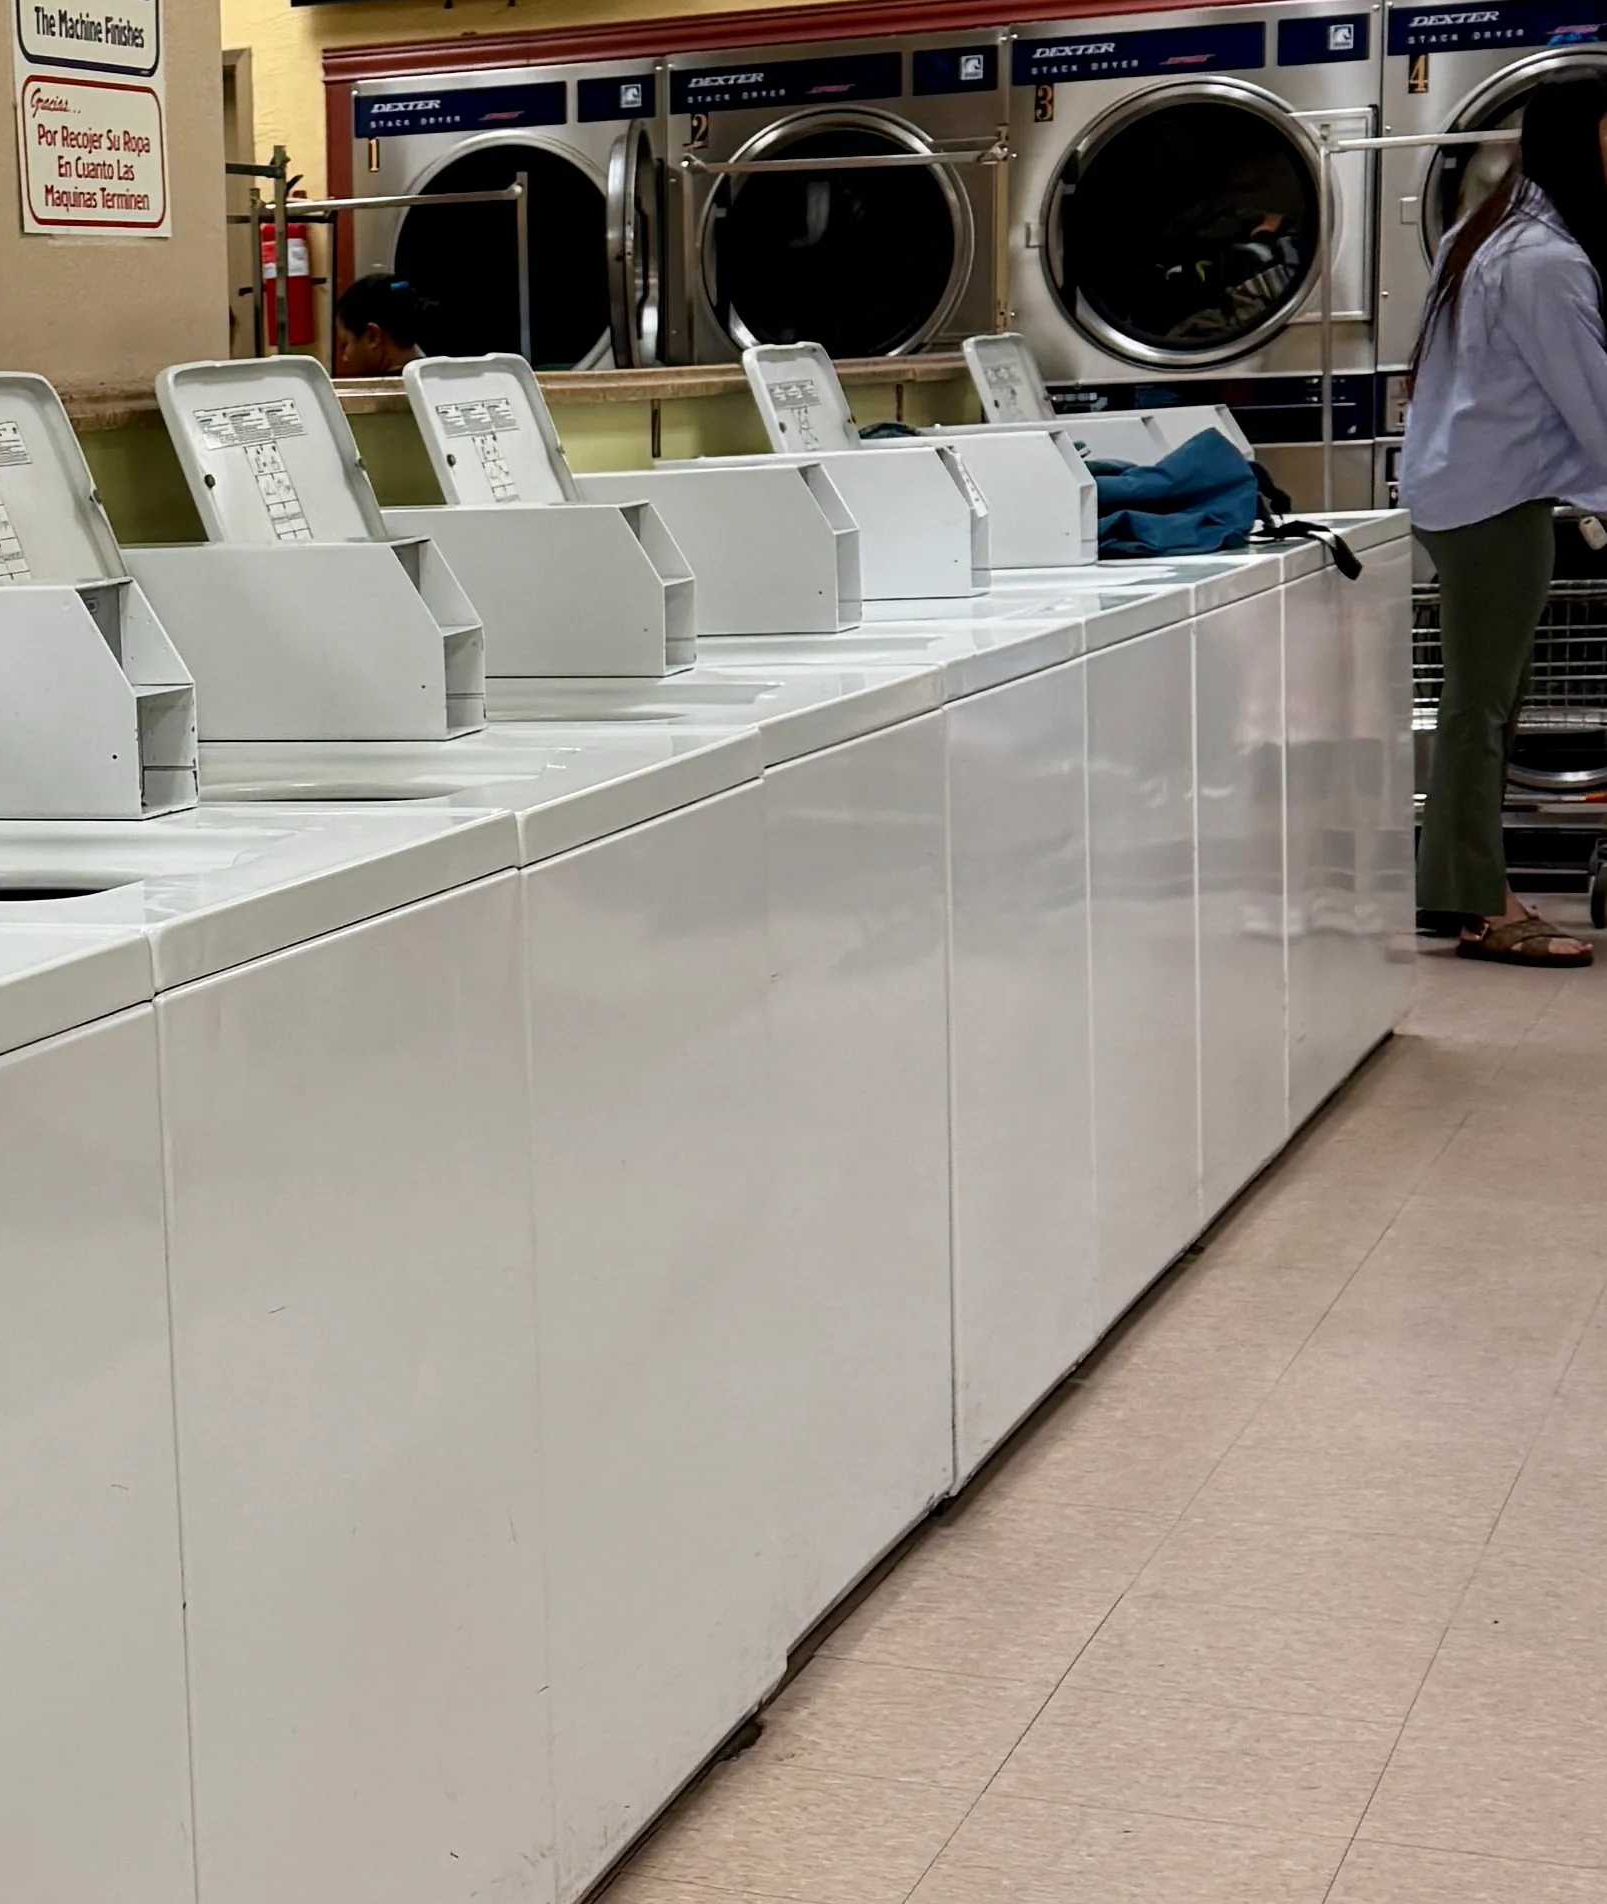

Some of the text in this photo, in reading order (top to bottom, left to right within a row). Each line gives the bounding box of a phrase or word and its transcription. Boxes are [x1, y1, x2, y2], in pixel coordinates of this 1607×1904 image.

[34, 6, 145, 49] The Machine Finishes
[1407, 10, 1500, 28] DEXTER
[1406, 28, 1525, 45] STACK DRYER
[1031, 42, 1116, 59] DEXTER
[687, 72, 765, 88] DEXTER
[1031, 64, 1078, 75] STACK
[1409, 55, 1429, 93] 4
[370, 99, 441, 114] DEXTER
[1036, 85, 1053, 121] 3
[37, 123, 151, 157] Por Recojer Su Ropa
[686, 113, 708, 150] 2
[57, 155, 135, 181] En Cuanto Las
[370, 138, 379, 171] 1
[44, 184, 150, 212] Maquinas Terminen
